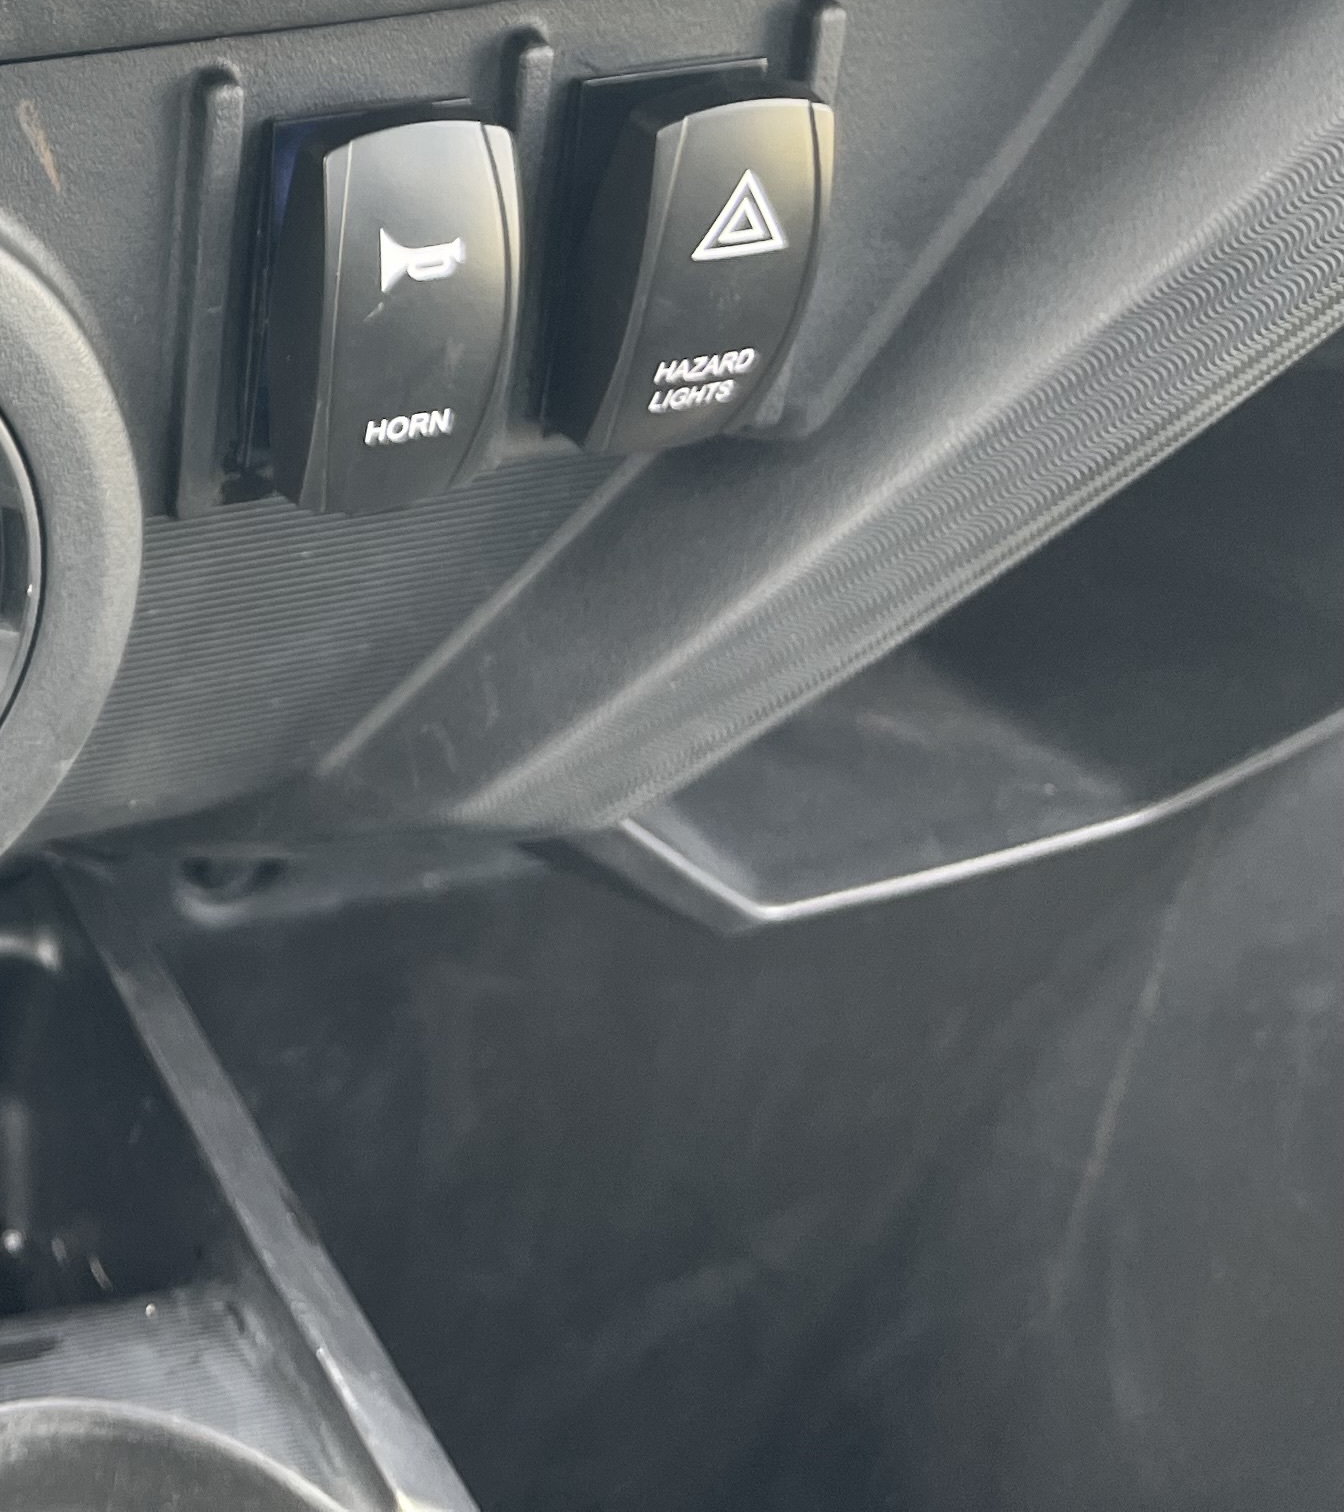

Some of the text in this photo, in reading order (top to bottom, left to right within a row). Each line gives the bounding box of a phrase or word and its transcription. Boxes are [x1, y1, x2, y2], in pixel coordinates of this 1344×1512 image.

[652, 346, 757, 385] HAZARD
[646, 377, 736, 415] LIGHTS
[363, 406, 454, 447] HORN
